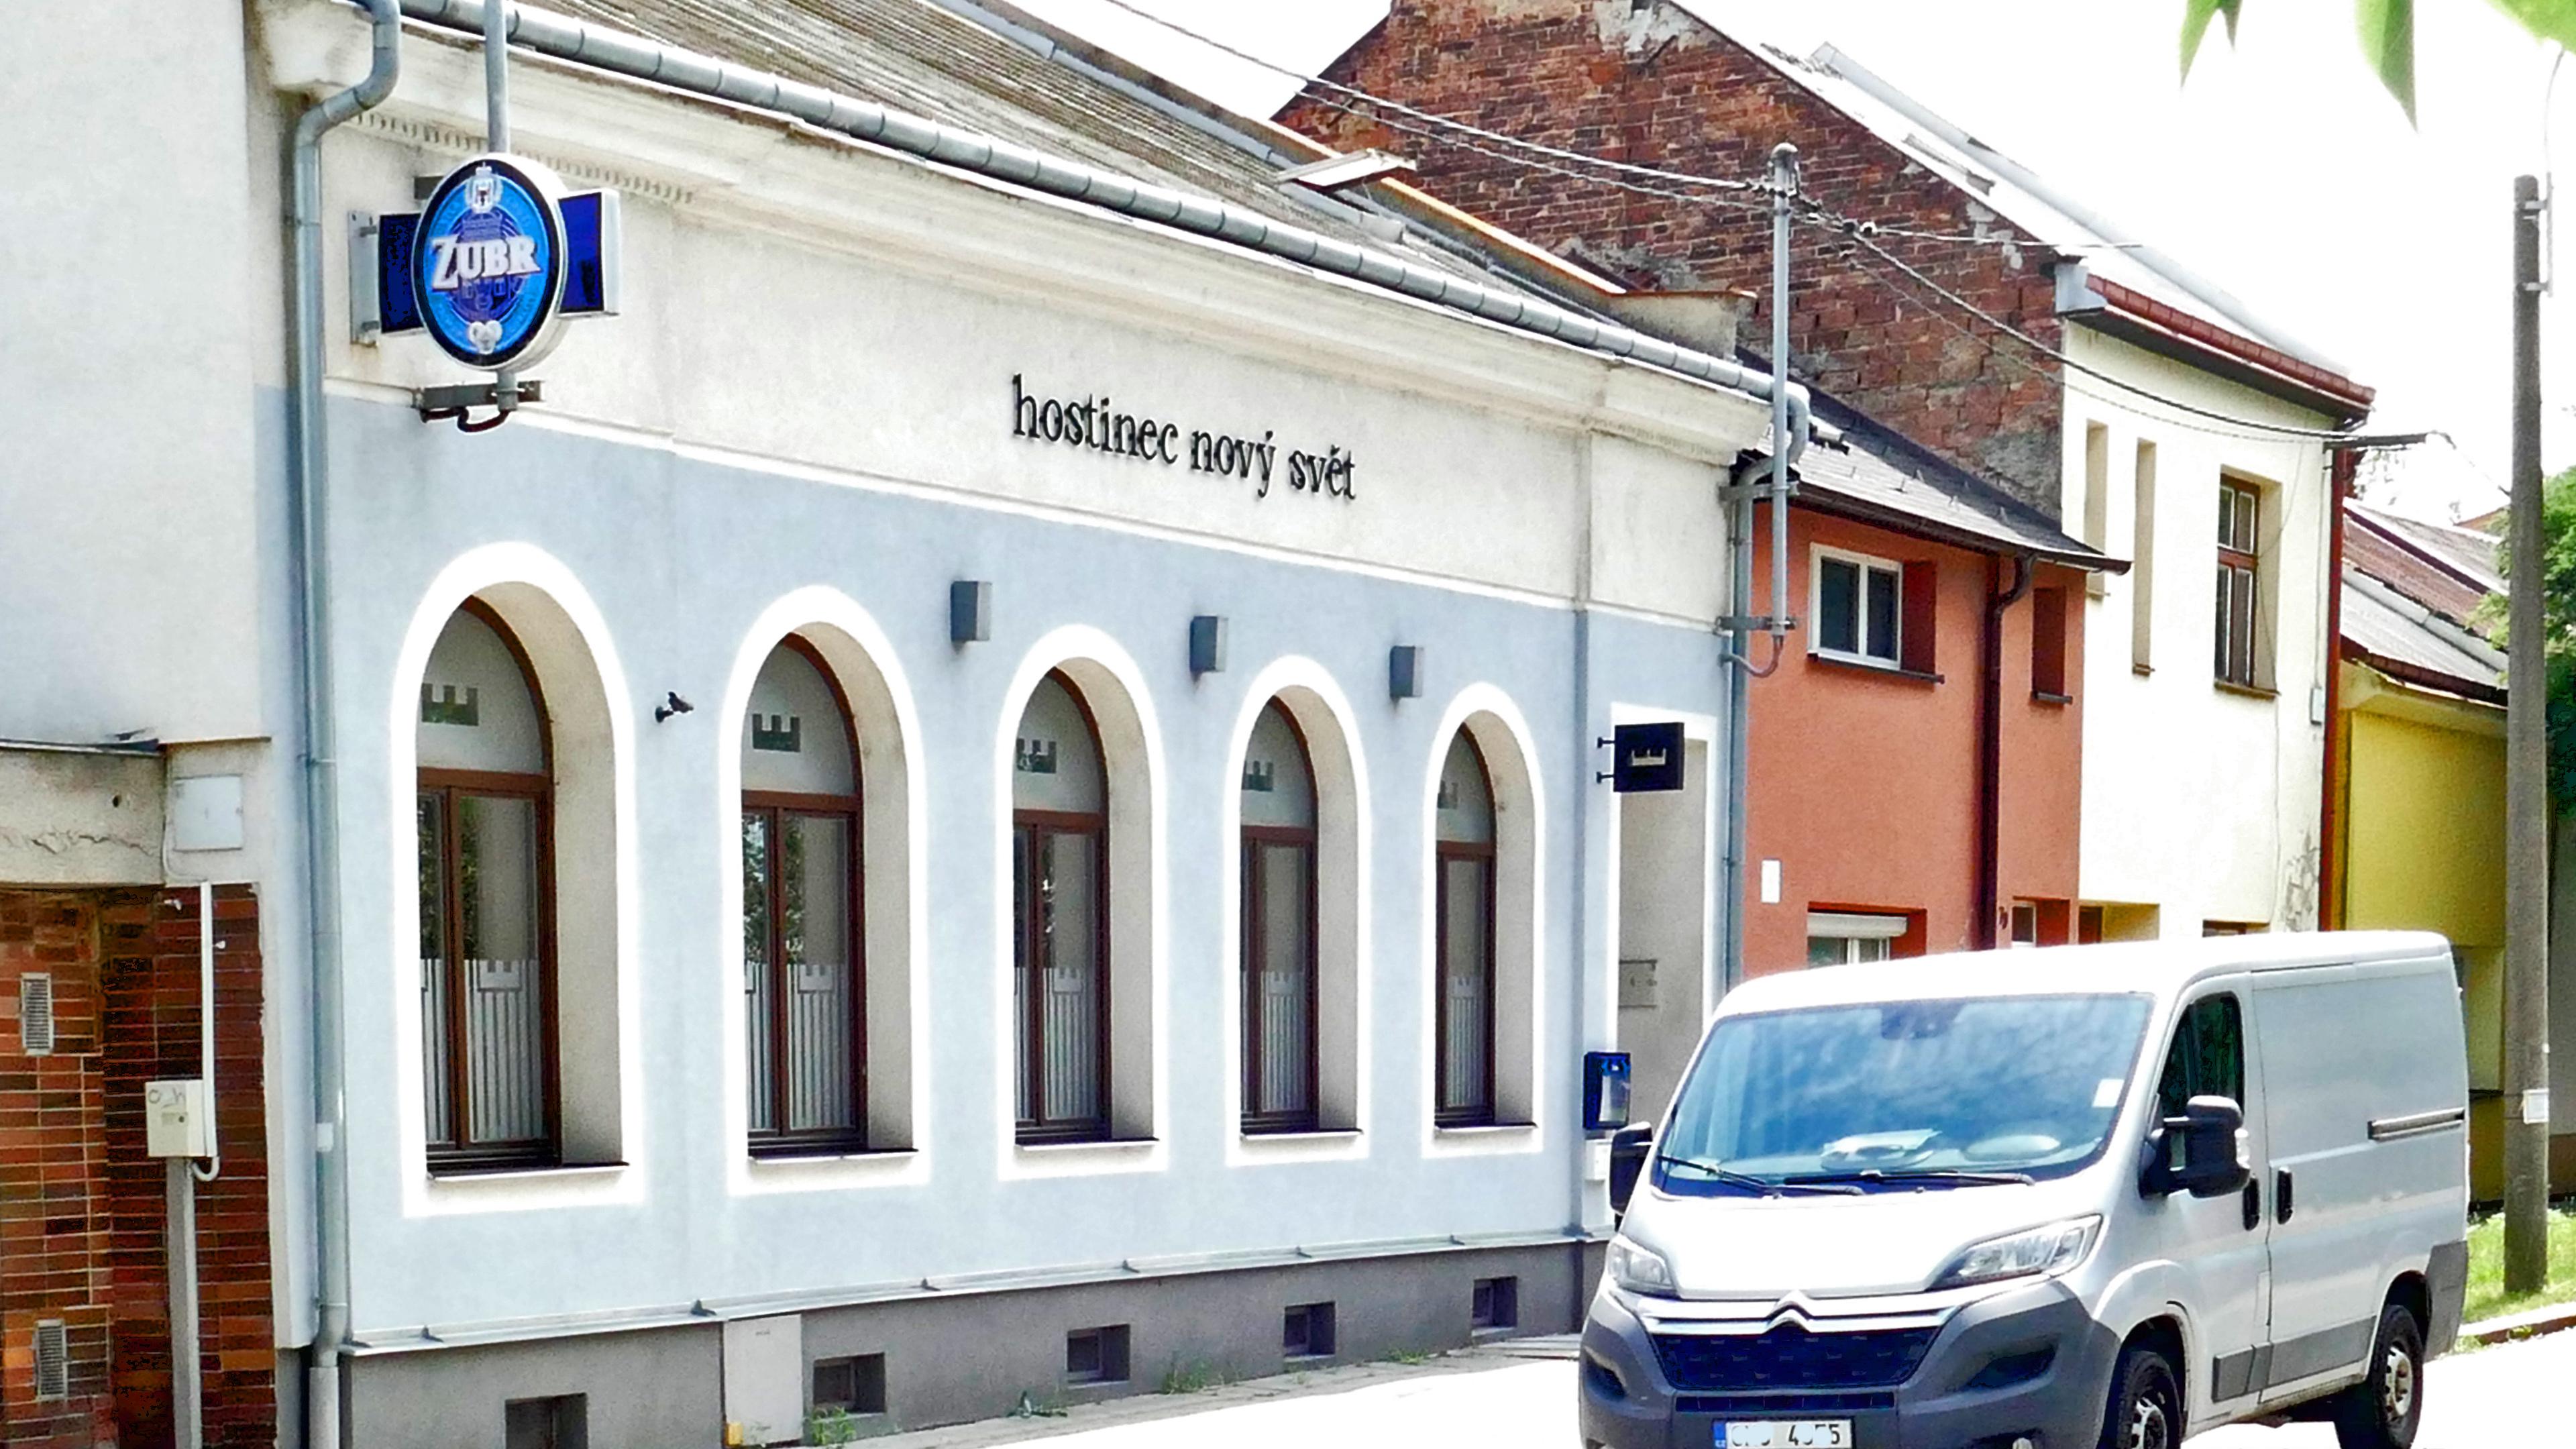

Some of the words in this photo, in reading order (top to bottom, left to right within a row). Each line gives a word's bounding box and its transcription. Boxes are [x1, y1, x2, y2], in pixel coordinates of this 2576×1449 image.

[430, 233, 541, 291] ZUBR
[1012, 373, 1179, 465] hostinec
[1190, 430, 1277, 499] nový
[1288, 443, 1356, 500] svět
